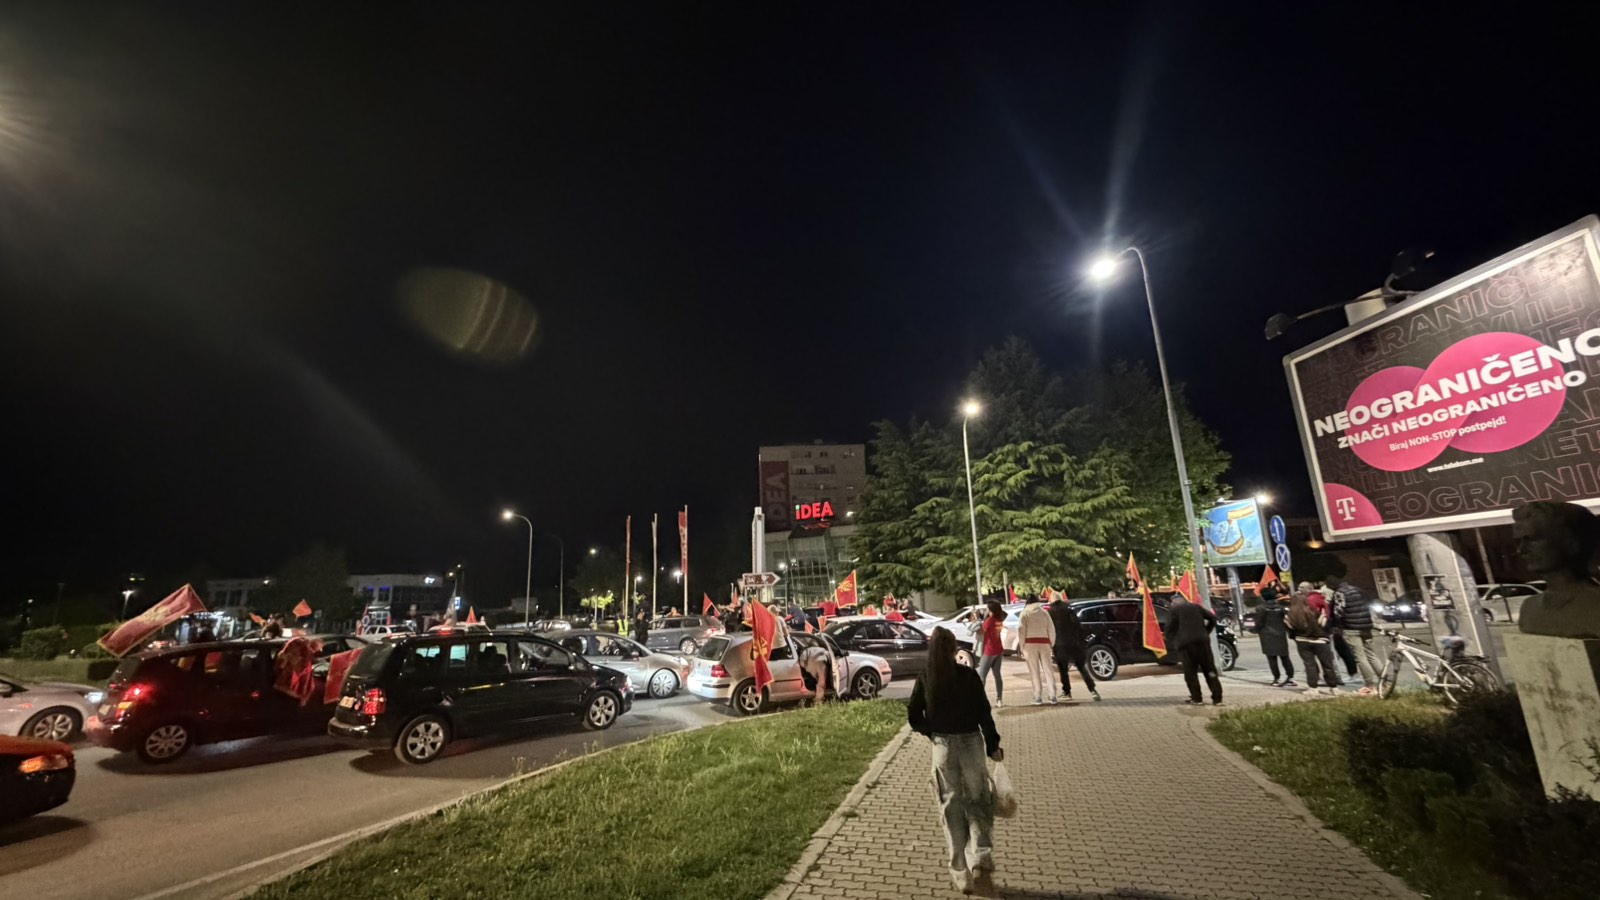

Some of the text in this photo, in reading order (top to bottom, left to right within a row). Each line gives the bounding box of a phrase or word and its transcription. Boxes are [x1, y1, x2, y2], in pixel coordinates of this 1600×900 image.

[1314, 327, 1600, 436] NEOGRANIČENO
[1337, 424, 1390, 449] ZNAČI
[1393, 370, 1587, 434] NEOGRANIČENO
[1389, 415, 1507, 452] Biraj NON-STOP postpejd!
[1335, 497, 1357, 521] T
[1374, 462, 1600, 521] EOGRANI
